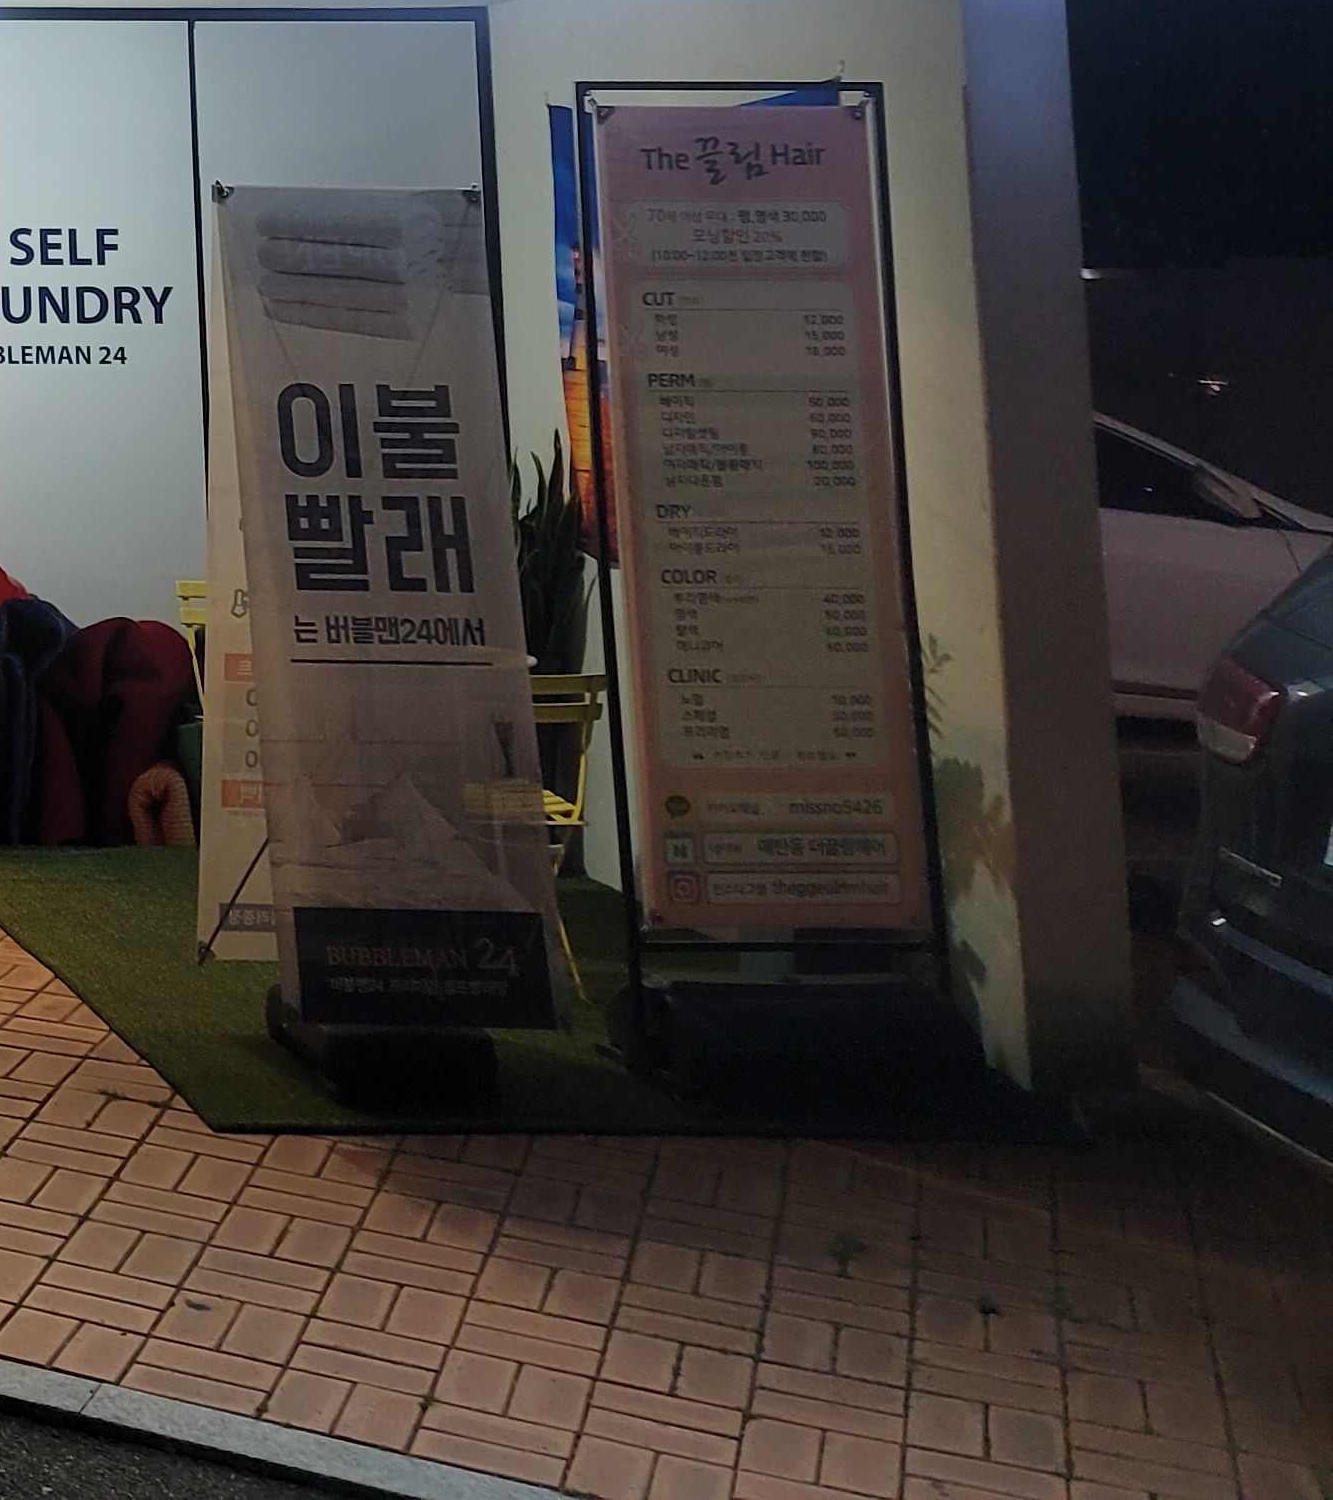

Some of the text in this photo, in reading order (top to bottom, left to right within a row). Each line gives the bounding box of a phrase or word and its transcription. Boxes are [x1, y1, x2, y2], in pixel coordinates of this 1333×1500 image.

[641, 147, 690, 171] The
[770, 142, 825, 166] Hair
[692, 228, 750, 244] 모닝할인
[9, 227, 120, 266] SELF
[641, 291, 676, 306] CUT
[98, 345, 128, 365] 24
[647, 372, 696, 388] PERM
[275, 381, 461, 481] 이불
[655, 503, 692, 519] DRY
[284, 493, 476, 595] 빨래
[660, 569, 718, 584] COLOR
[293, 614, 487, 647] 는 버블맨24에서
[667, 668, 723, 684] CLINIC
[324, 937, 521, 978] BUBBLEMAN 24
